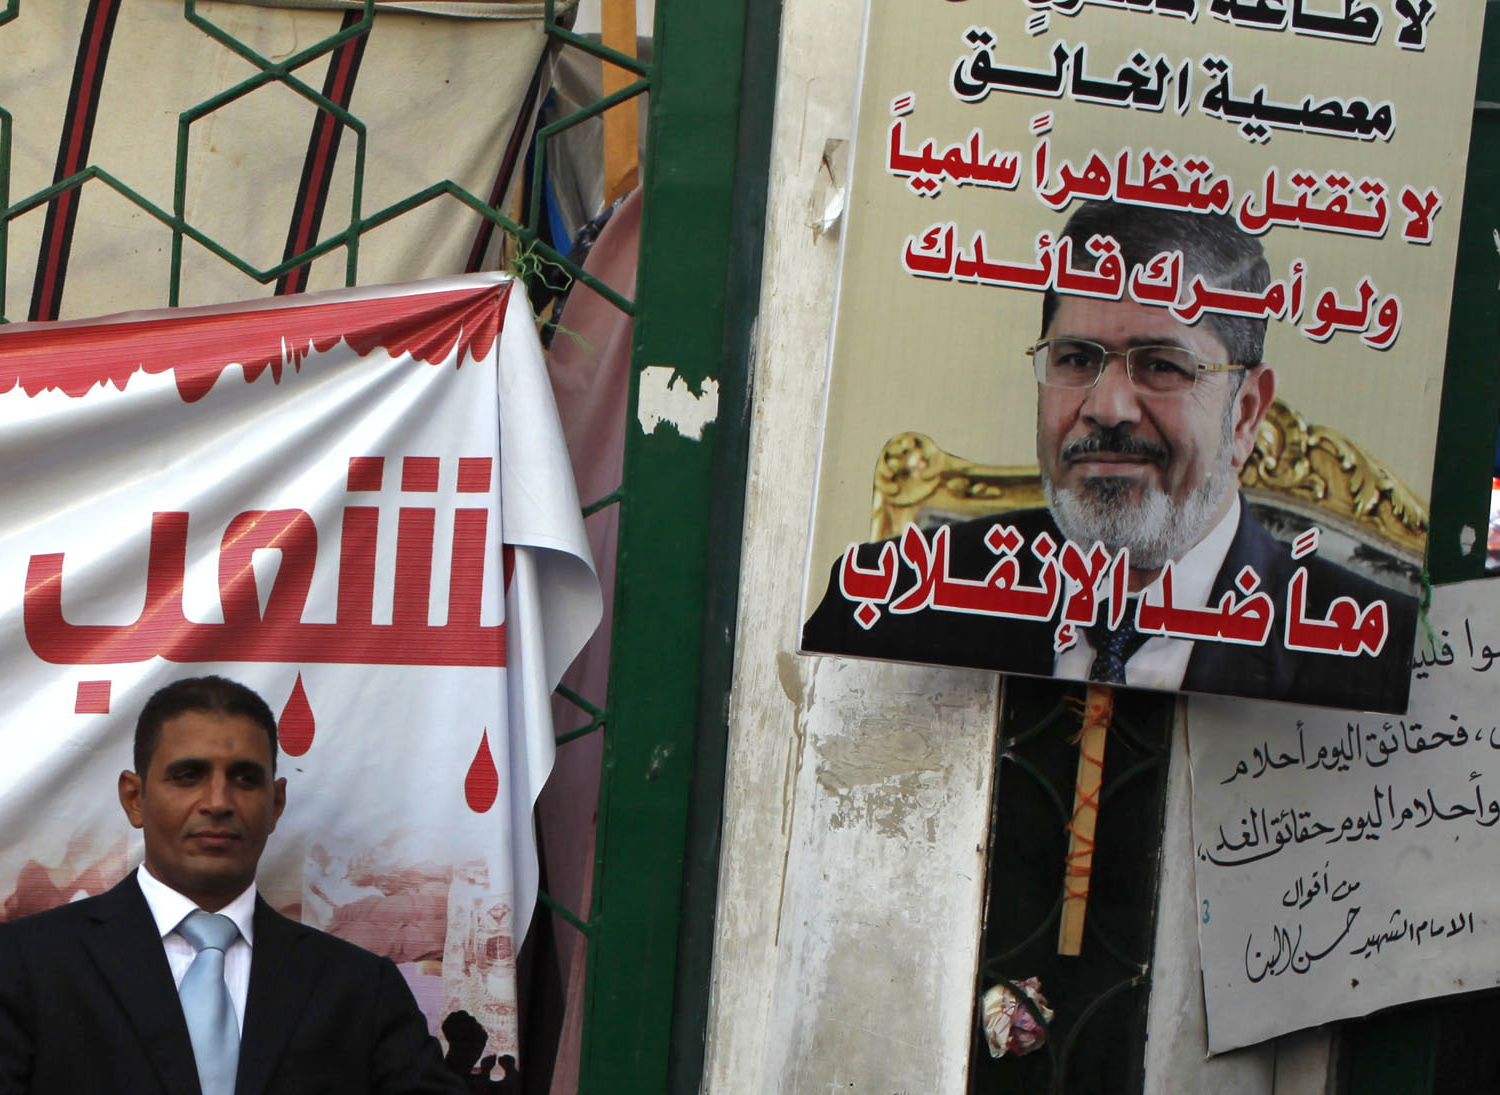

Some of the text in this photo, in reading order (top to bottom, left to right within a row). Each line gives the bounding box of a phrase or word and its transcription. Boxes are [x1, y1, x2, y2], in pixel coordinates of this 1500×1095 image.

[955, 30, 1394, 142] معصية الخالق
[888, 98, 1438, 240] لا تقتل متظاهراً سلمياً
[904, 226, 1400, 345] ولو أمرك قائدك
[841, 524, 1388, 656] معاً ضد الإنقلاب
[1220, 720, 1305, 785] أحلام
[1306, 722, 1361, 771] اليوم
[1366, 714, 1468, 768] فحقائق
[1325, 784, 1395, 844] اليوم
[1282, 860, 1361, 910] من أقوال
